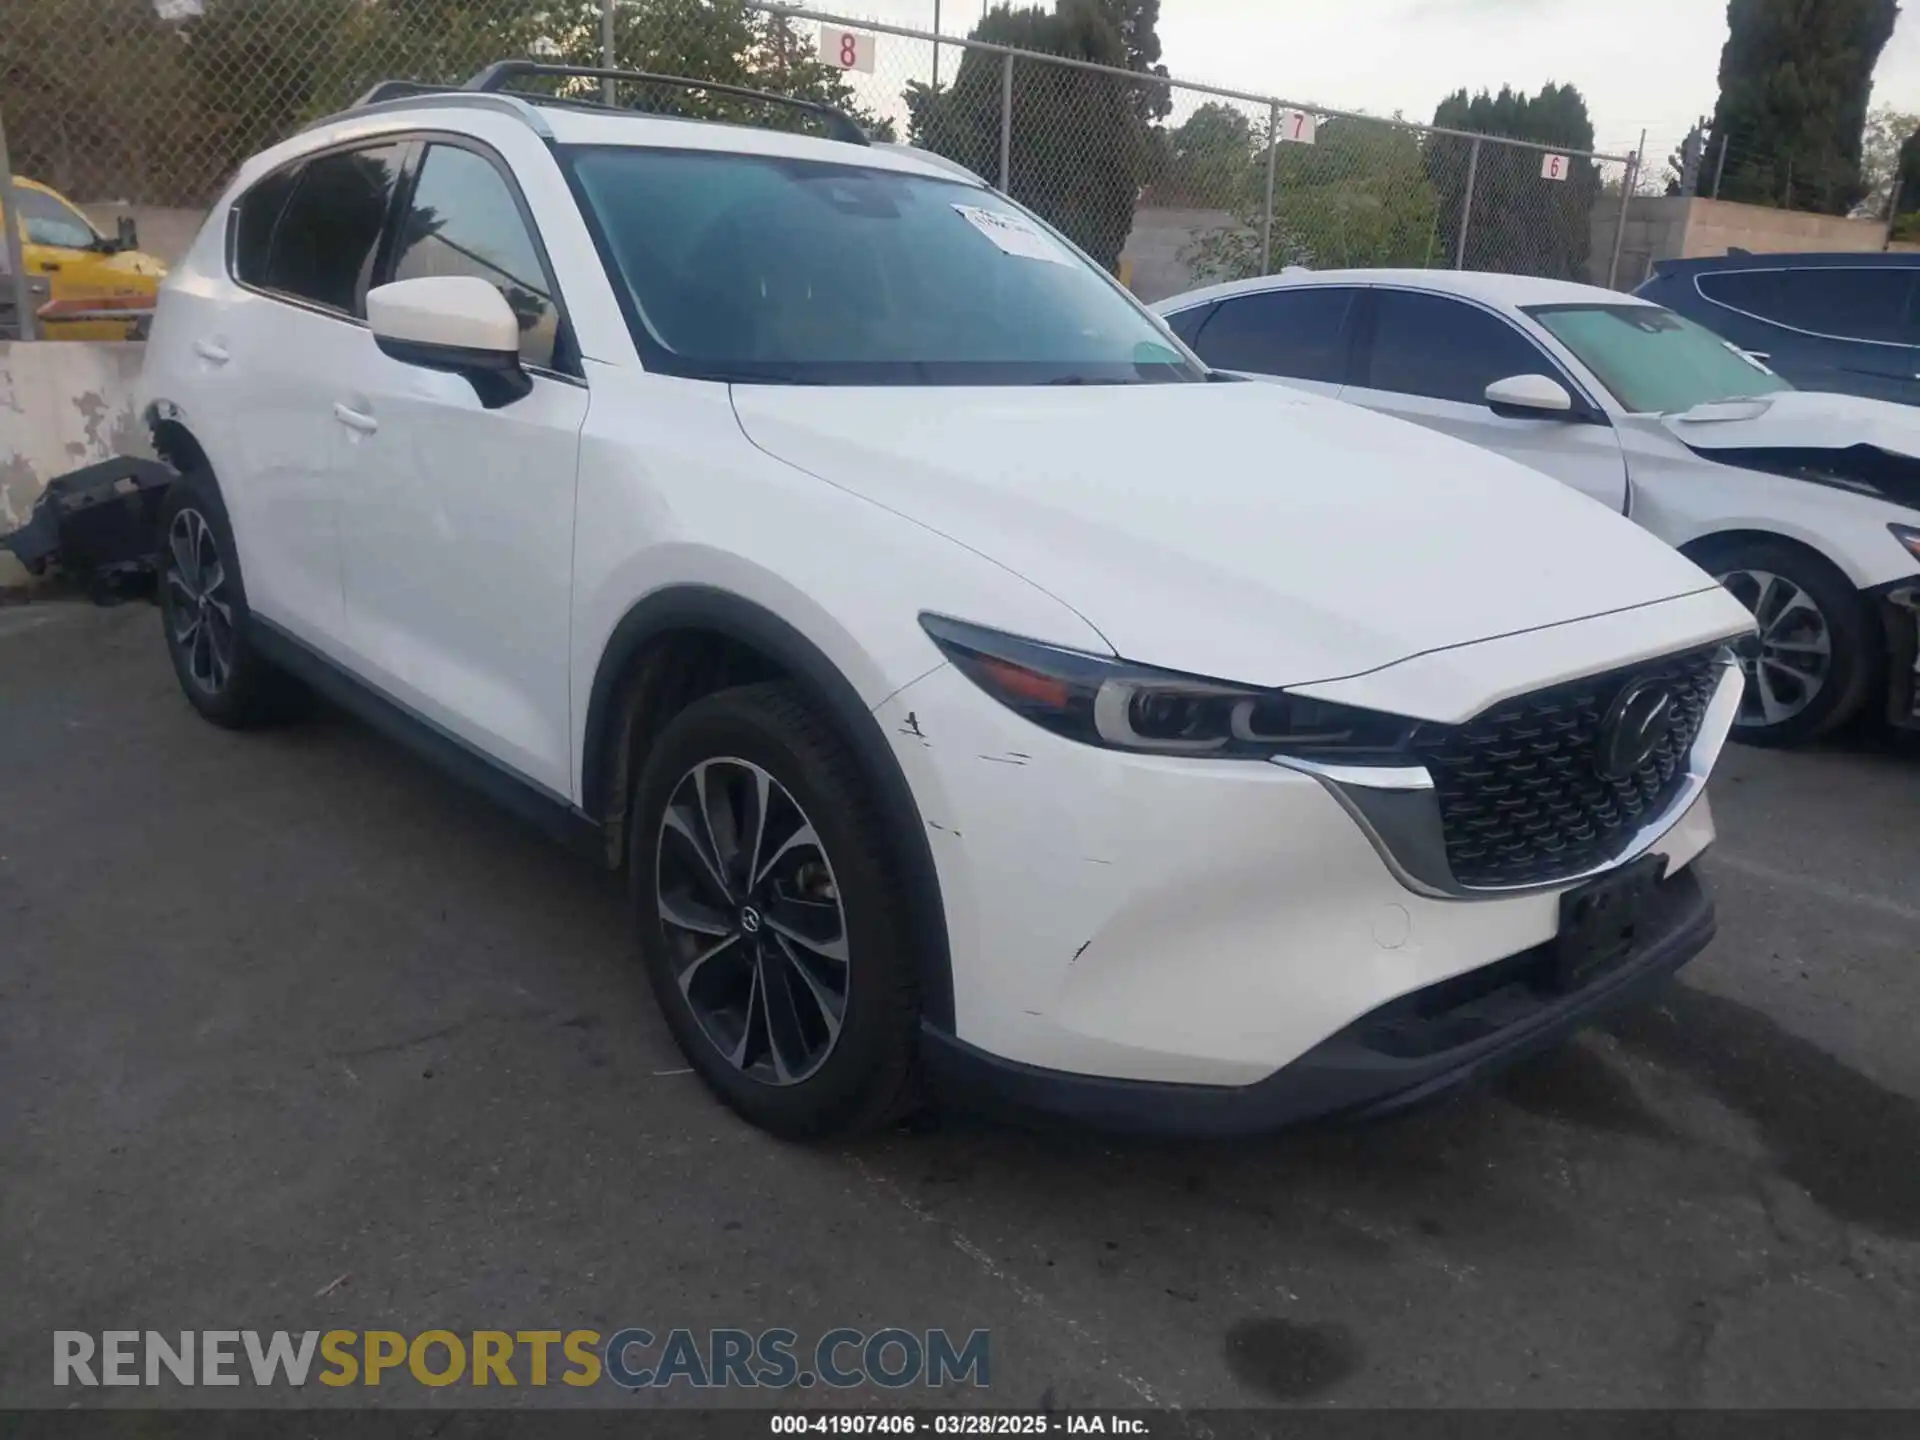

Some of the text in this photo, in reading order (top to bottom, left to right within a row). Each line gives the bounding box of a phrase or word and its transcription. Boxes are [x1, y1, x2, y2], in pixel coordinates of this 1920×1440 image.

[840, 33, 856, 67] 8
[1294, 114, 1304, 138] 7
[1550, 156, 1560, 177] 6
